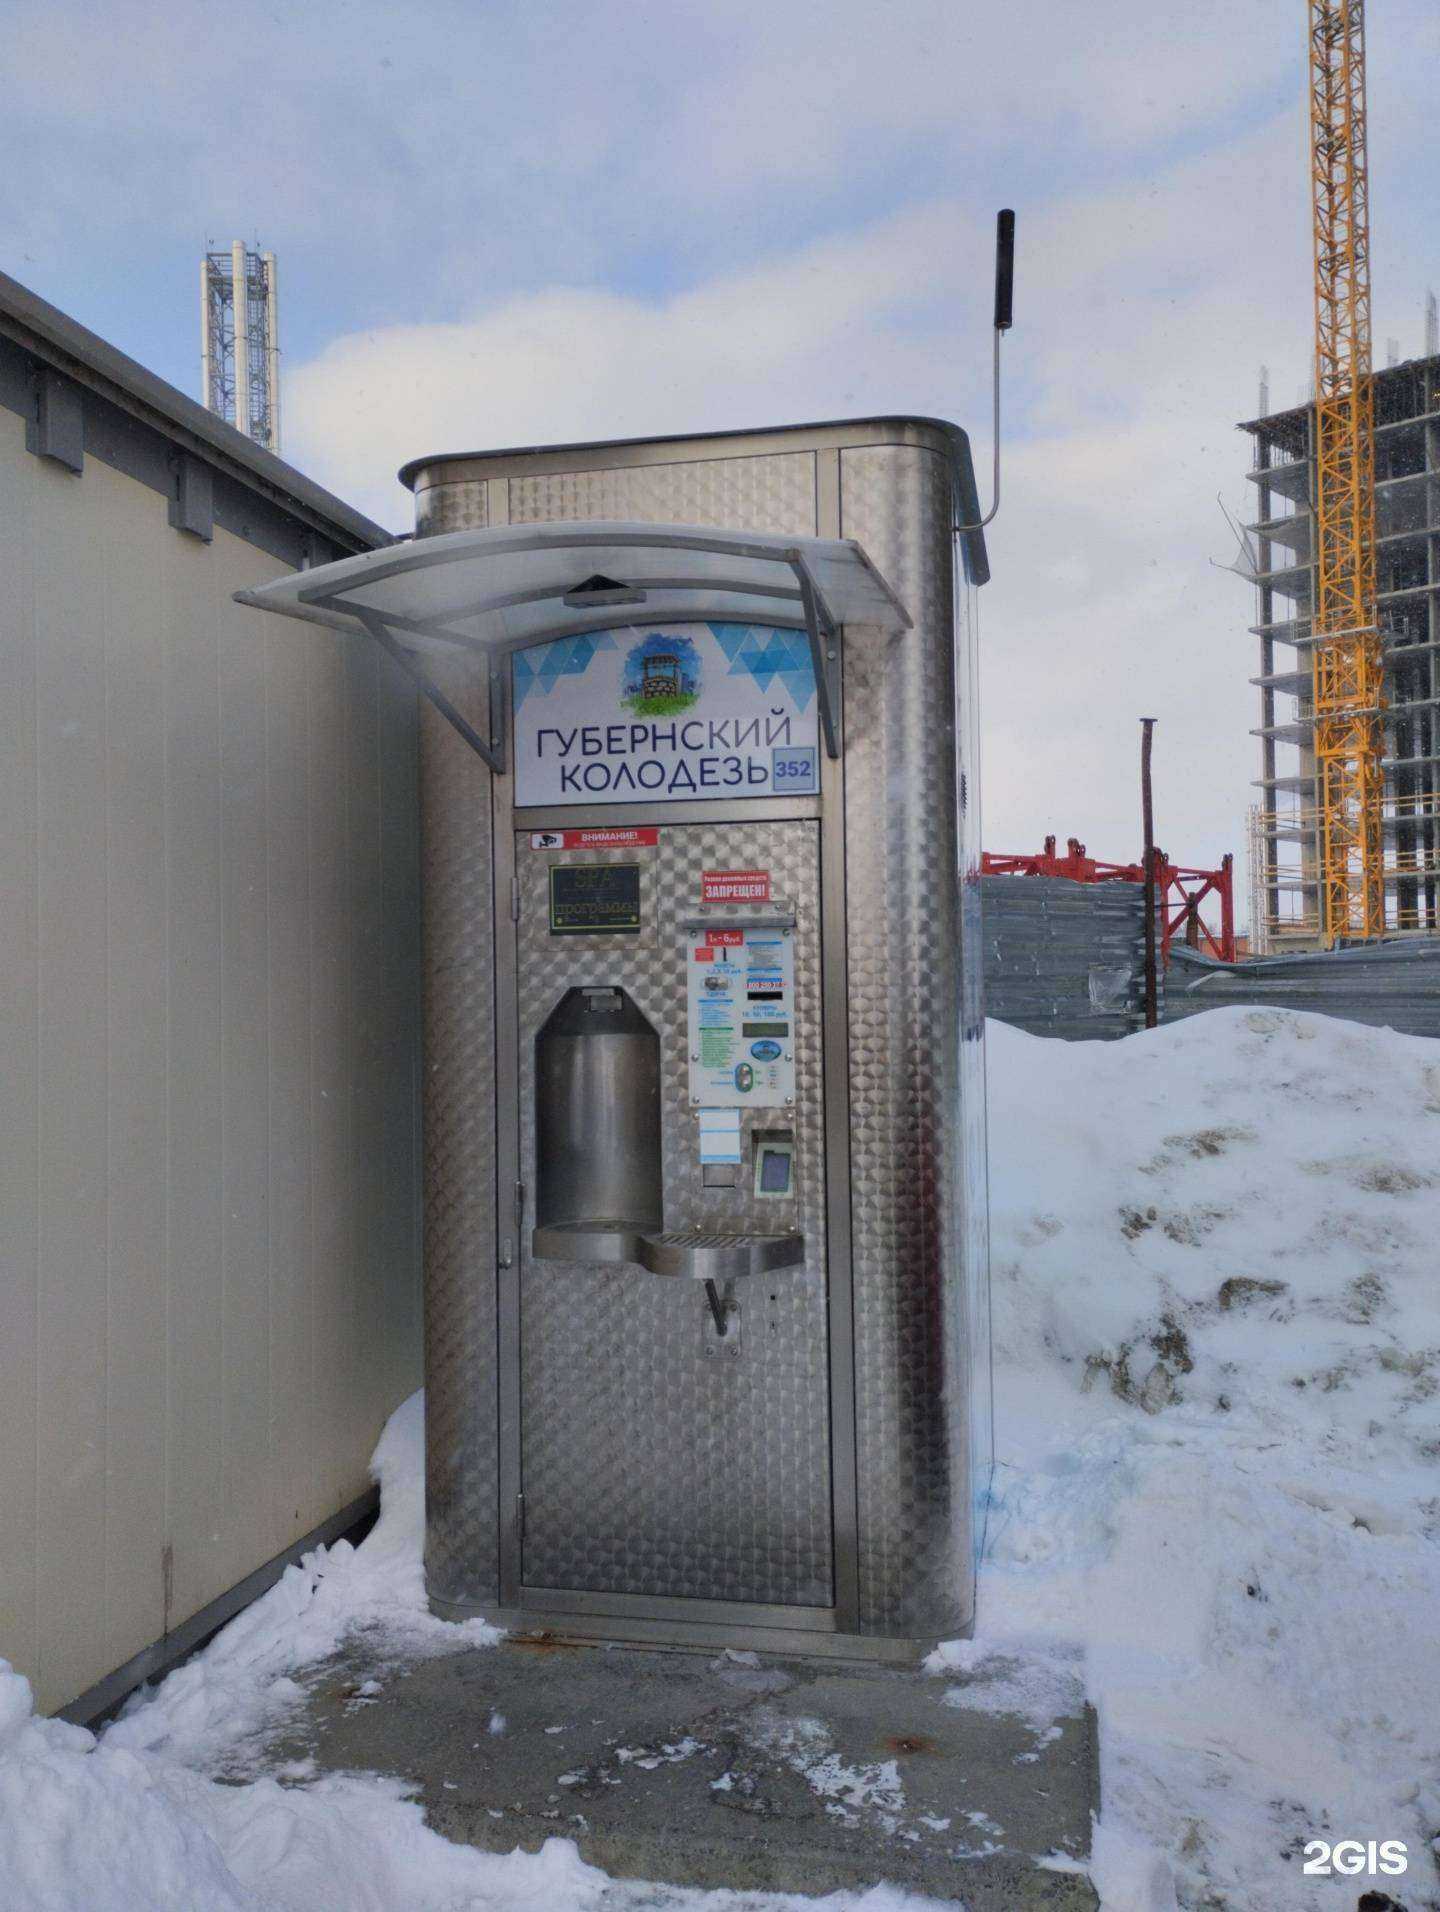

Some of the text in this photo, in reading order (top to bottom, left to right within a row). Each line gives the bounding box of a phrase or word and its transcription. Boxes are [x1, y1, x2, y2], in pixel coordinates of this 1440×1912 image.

[537, 707, 791, 758] ГУБЕРНСКИЙ
[560, 755, 769, 794] КОЛОДЕЗЬ
[775, 760, 812, 778] 352
[581, 831, 638, 842] ВНИМАНИЕ!
[705, 883, 766, 898] ЗАПРЕЩЕН!
